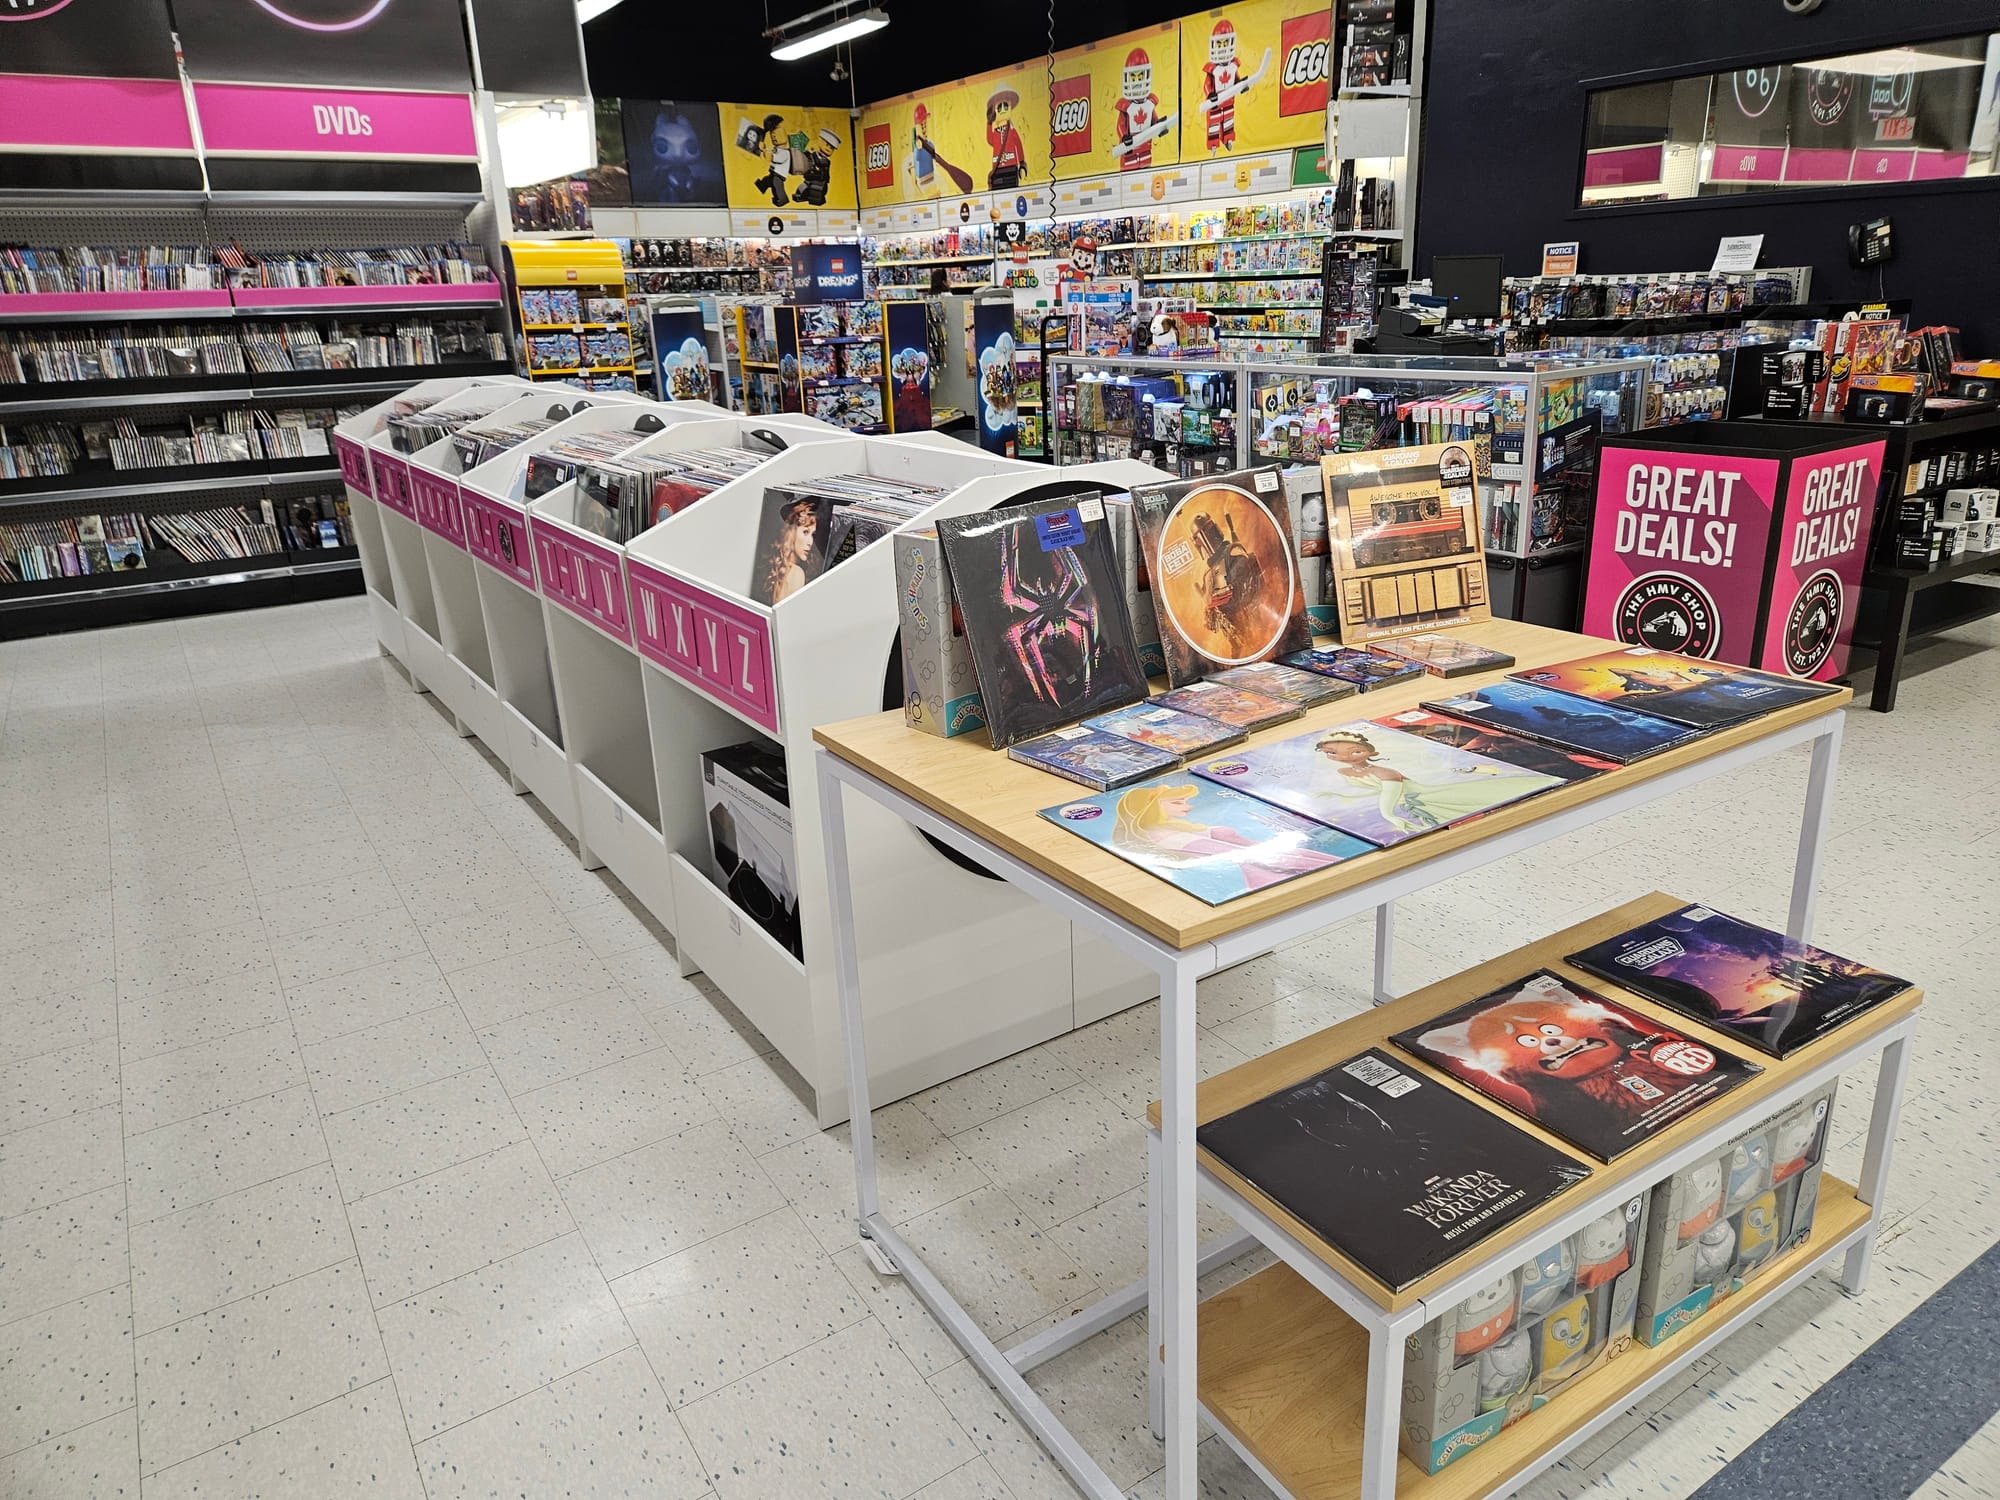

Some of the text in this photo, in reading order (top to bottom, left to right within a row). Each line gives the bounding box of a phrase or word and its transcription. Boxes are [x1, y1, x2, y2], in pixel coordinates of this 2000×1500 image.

[313, 105, 373, 137] DVDs
[1054, 98, 1088, 135] LEGO
[868, 143, 890, 170] LEGO
[1549, 246, 1573, 255] NOTICE
[1003, 276, 1039, 289] MARIO
[1007, 268, 1035, 279] SUPER
[1862, 303, 1888, 311] CLEARANCE
[1865, 312, 1883, 320] NOTICE
[1142, 493, 1168, 504] BOBA
[1370, 491, 1402, 502] AWESOME
[1625, 463, 1741, 518] GREAT
[1802, 458, 1868, 516] GREAT
[1144, 501, 1168, 512] FETT
[1614, 510, 1738, 569] DEALS!
[1790, 507, 1860, 568] DEALS!
[1165, 543, 1188, 561] BOBA
[1168, 552, 1193, 571] FETT
[1625, 583, 1707, 631] THE HMV SHOP
[1792, 582, 1837, 631] THE HMV SHOP
[1391, 626, 1412, 636] MOTION
[1412, 622, 1435, 632] PICTURE
[1435, 617, 1471, 628] SOUNDTRACK
[1793, 642, 1826, 667] EST. 1921
[1620, 939, 1674, 964] GUARDIANS
[1653, 1041, 1692, 1063] TURNING
[1664, 1047, 1715, 1075] RED
[1403, 1169, 1495, 1217] WAKANDA
[1425, 1178, 1512, 1229] FOREVER
[1443, 1189, 1527, 1240] MUSIC FROM AND INSPIRED BY
